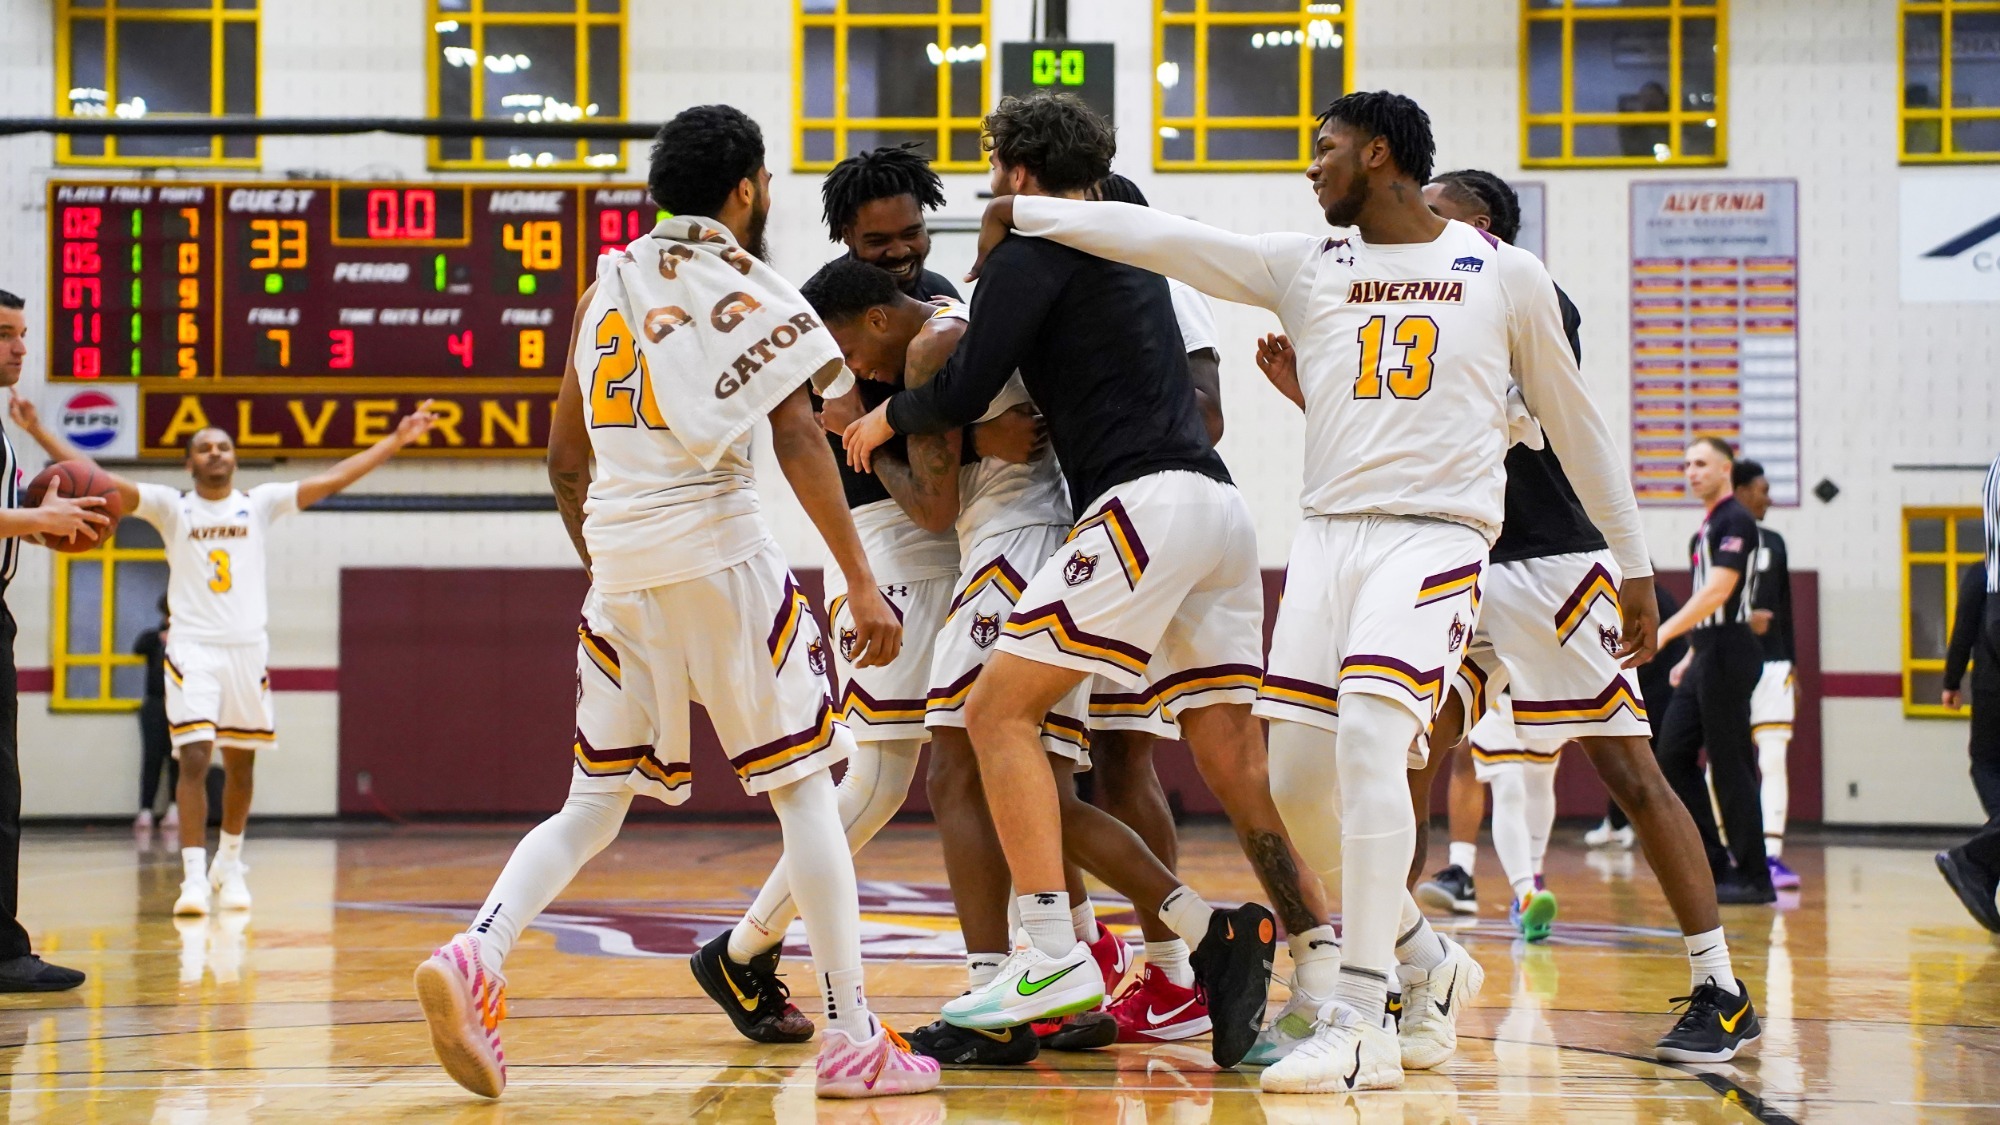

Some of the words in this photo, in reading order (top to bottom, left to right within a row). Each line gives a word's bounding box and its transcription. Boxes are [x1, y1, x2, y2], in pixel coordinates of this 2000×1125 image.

[228, 188, 315, 213] GUEST
[488, 190, 565, 214] HOME
[1663, 192, 1765, 213] ALVERNIA
[63, 207, 101, 239] 02
[131, 208, 143, 239] 1
[179, 207, 199, 239] 7
[131, 242, 143, 274] 1
[178, 242, 199, 275] 0
[249, 219, 308, 270] 33
[502, 220, 562, 270] 48
[333, 262, 410, 283] PERIOD
[434, 253, 447, 292] 1
[1453, 262, 1482, 275] MAC
[62, 277, 101, 309] 07
[131, 277, 143, 309] 1
[1346, 281, 1464, 304] ALVERNIA
[73, 312, 101, 344] 11
[131, 312, 142, 344] 1
[247, 307, 300, 326] FOULS
[338, 307, 377, 326] TIME
[378, 307, 420, 326] OUTS
[422, 307, 462, 326] LEFT
[501, 307, 554, 326] FOULS
[130, 347, 142, 377] 1
[266, 329, 290, 368] 7
[328, 329, 354, 369] 3
[447, 329, 473, 368] 4
[519, 329, 545, 368] 8
[1353, 315, 1440, 400] 13
[63, 412, 118, 427] PEPSI
[160, 395, 558, 447] ALVERN
[188, 525, 247, 541] ALVERNIA
[208, 548, 232, 593] 3
